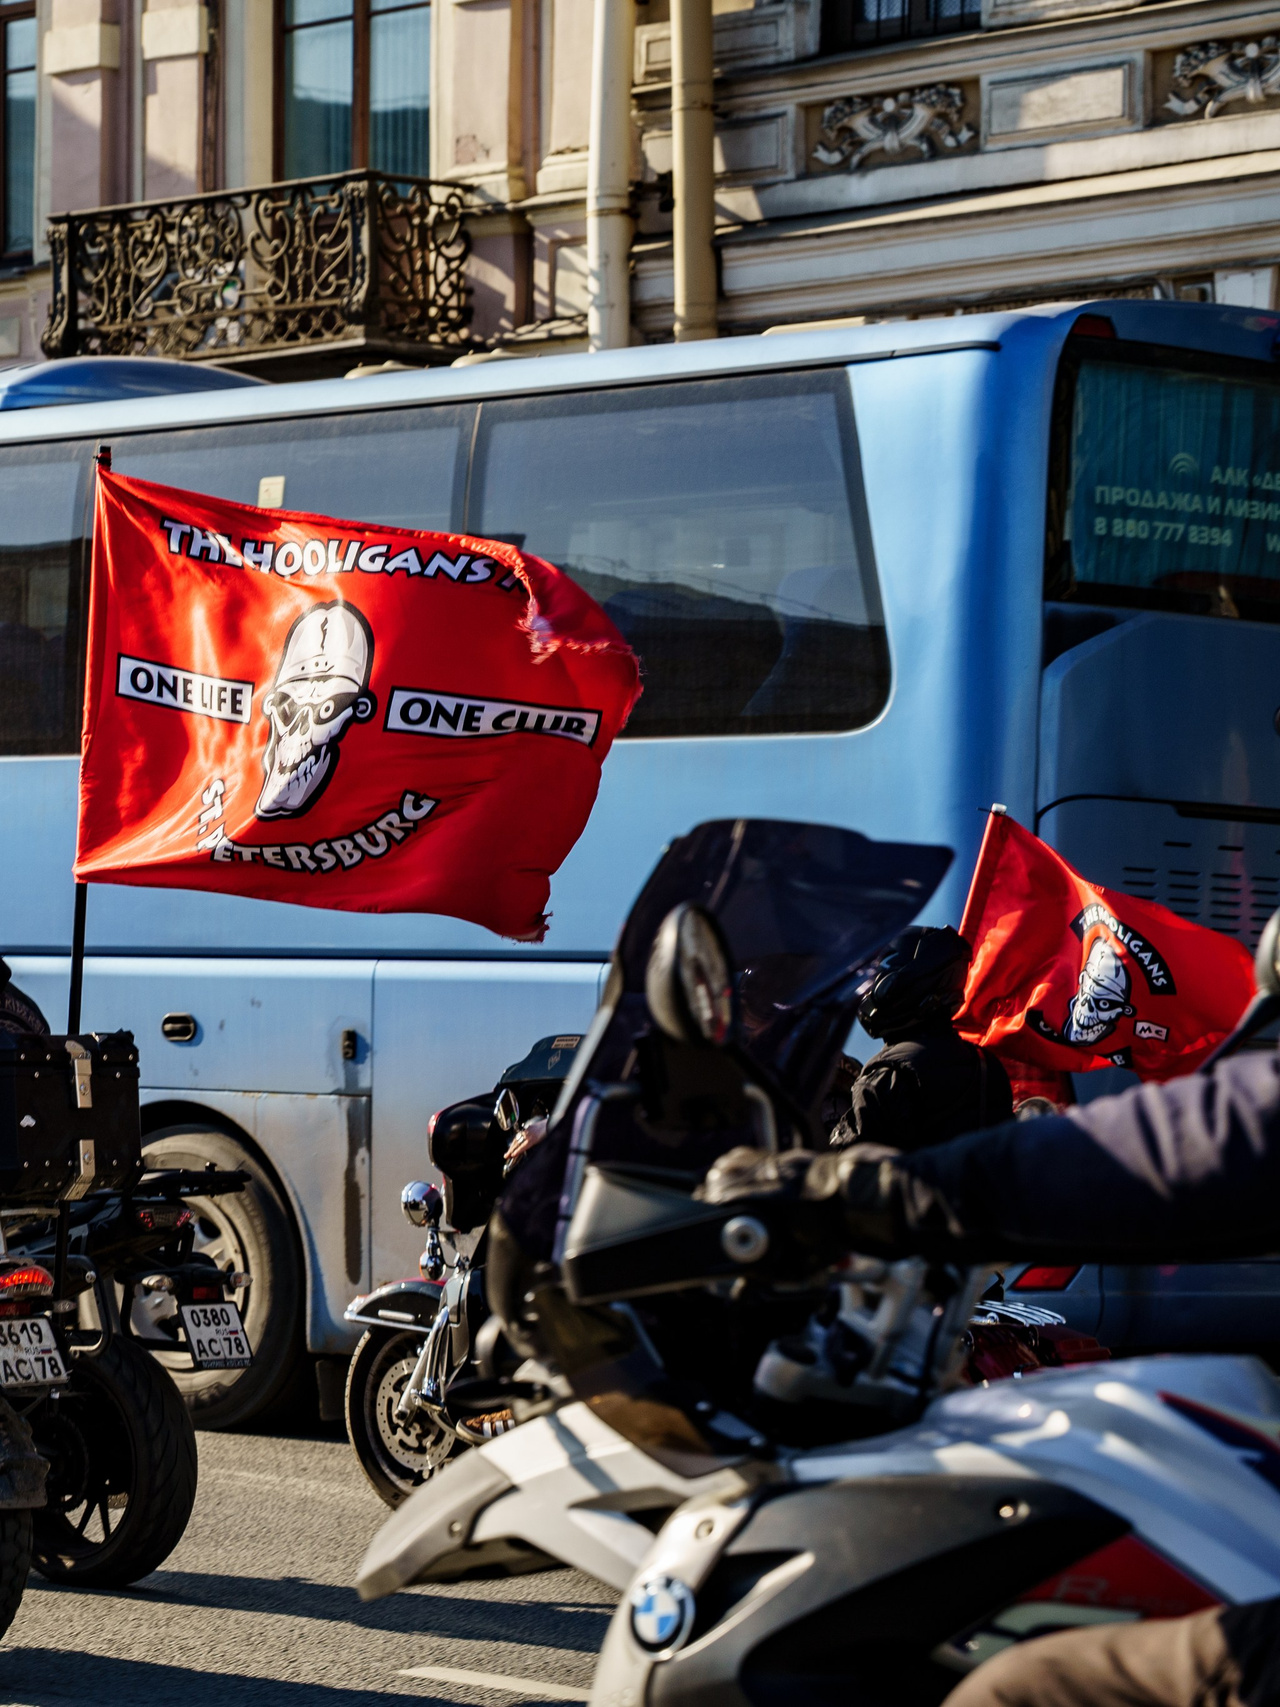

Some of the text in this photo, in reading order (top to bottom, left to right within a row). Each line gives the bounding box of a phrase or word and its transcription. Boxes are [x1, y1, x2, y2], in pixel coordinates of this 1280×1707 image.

[1094, 485, 1204, 513] ПРОДАЖА
[1206, 495, 1221, 515] И
[1151, 521, 1186, 542] 777
[243, 539, 495, 583] HOOLIGANS
[129, 666, 245, 717] ONE LIFE
[400, 697, 485, 733] ONE
[1138, 1025, 1164, 1038] MC
[190, 1307, 231, 1328] 0380
[223, 1336, 245, 1356] 78
[34, 1356, 62, 1380] 78
